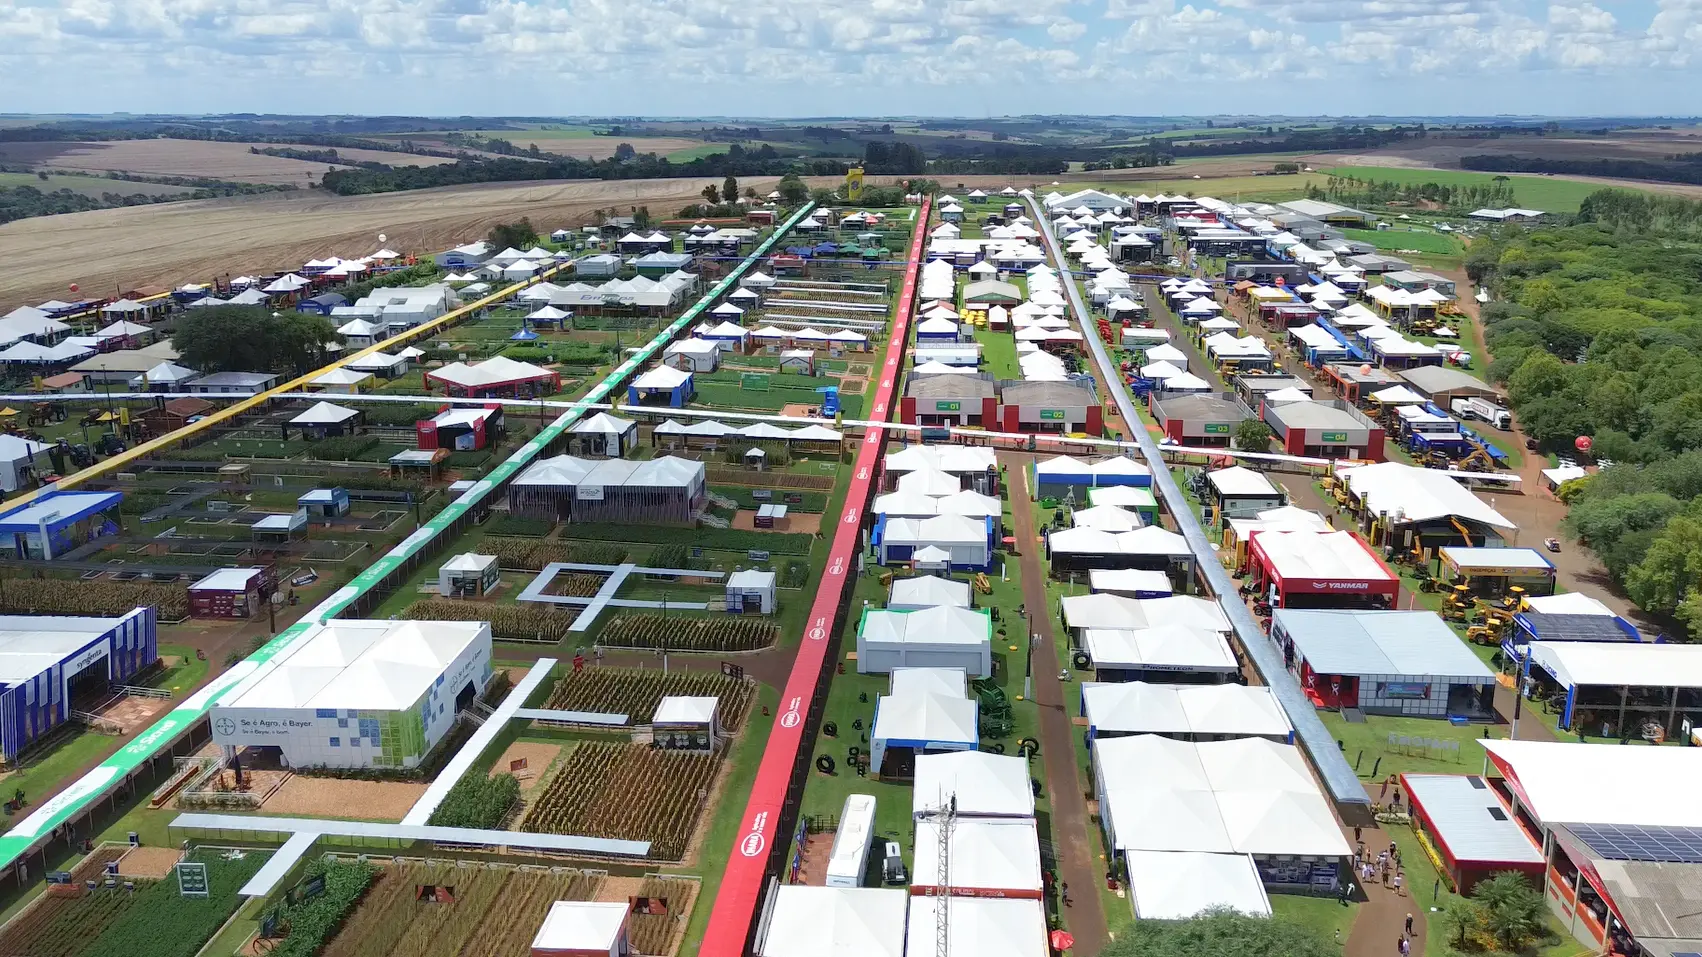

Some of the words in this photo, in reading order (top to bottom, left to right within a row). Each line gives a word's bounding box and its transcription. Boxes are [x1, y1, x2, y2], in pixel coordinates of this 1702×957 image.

[76, 649, 102, 669] syngenta
[259, 719, 281, 728] Agro,
[282, 719, 287, 727] é
[288, 719, 313, 728] Bayer.
